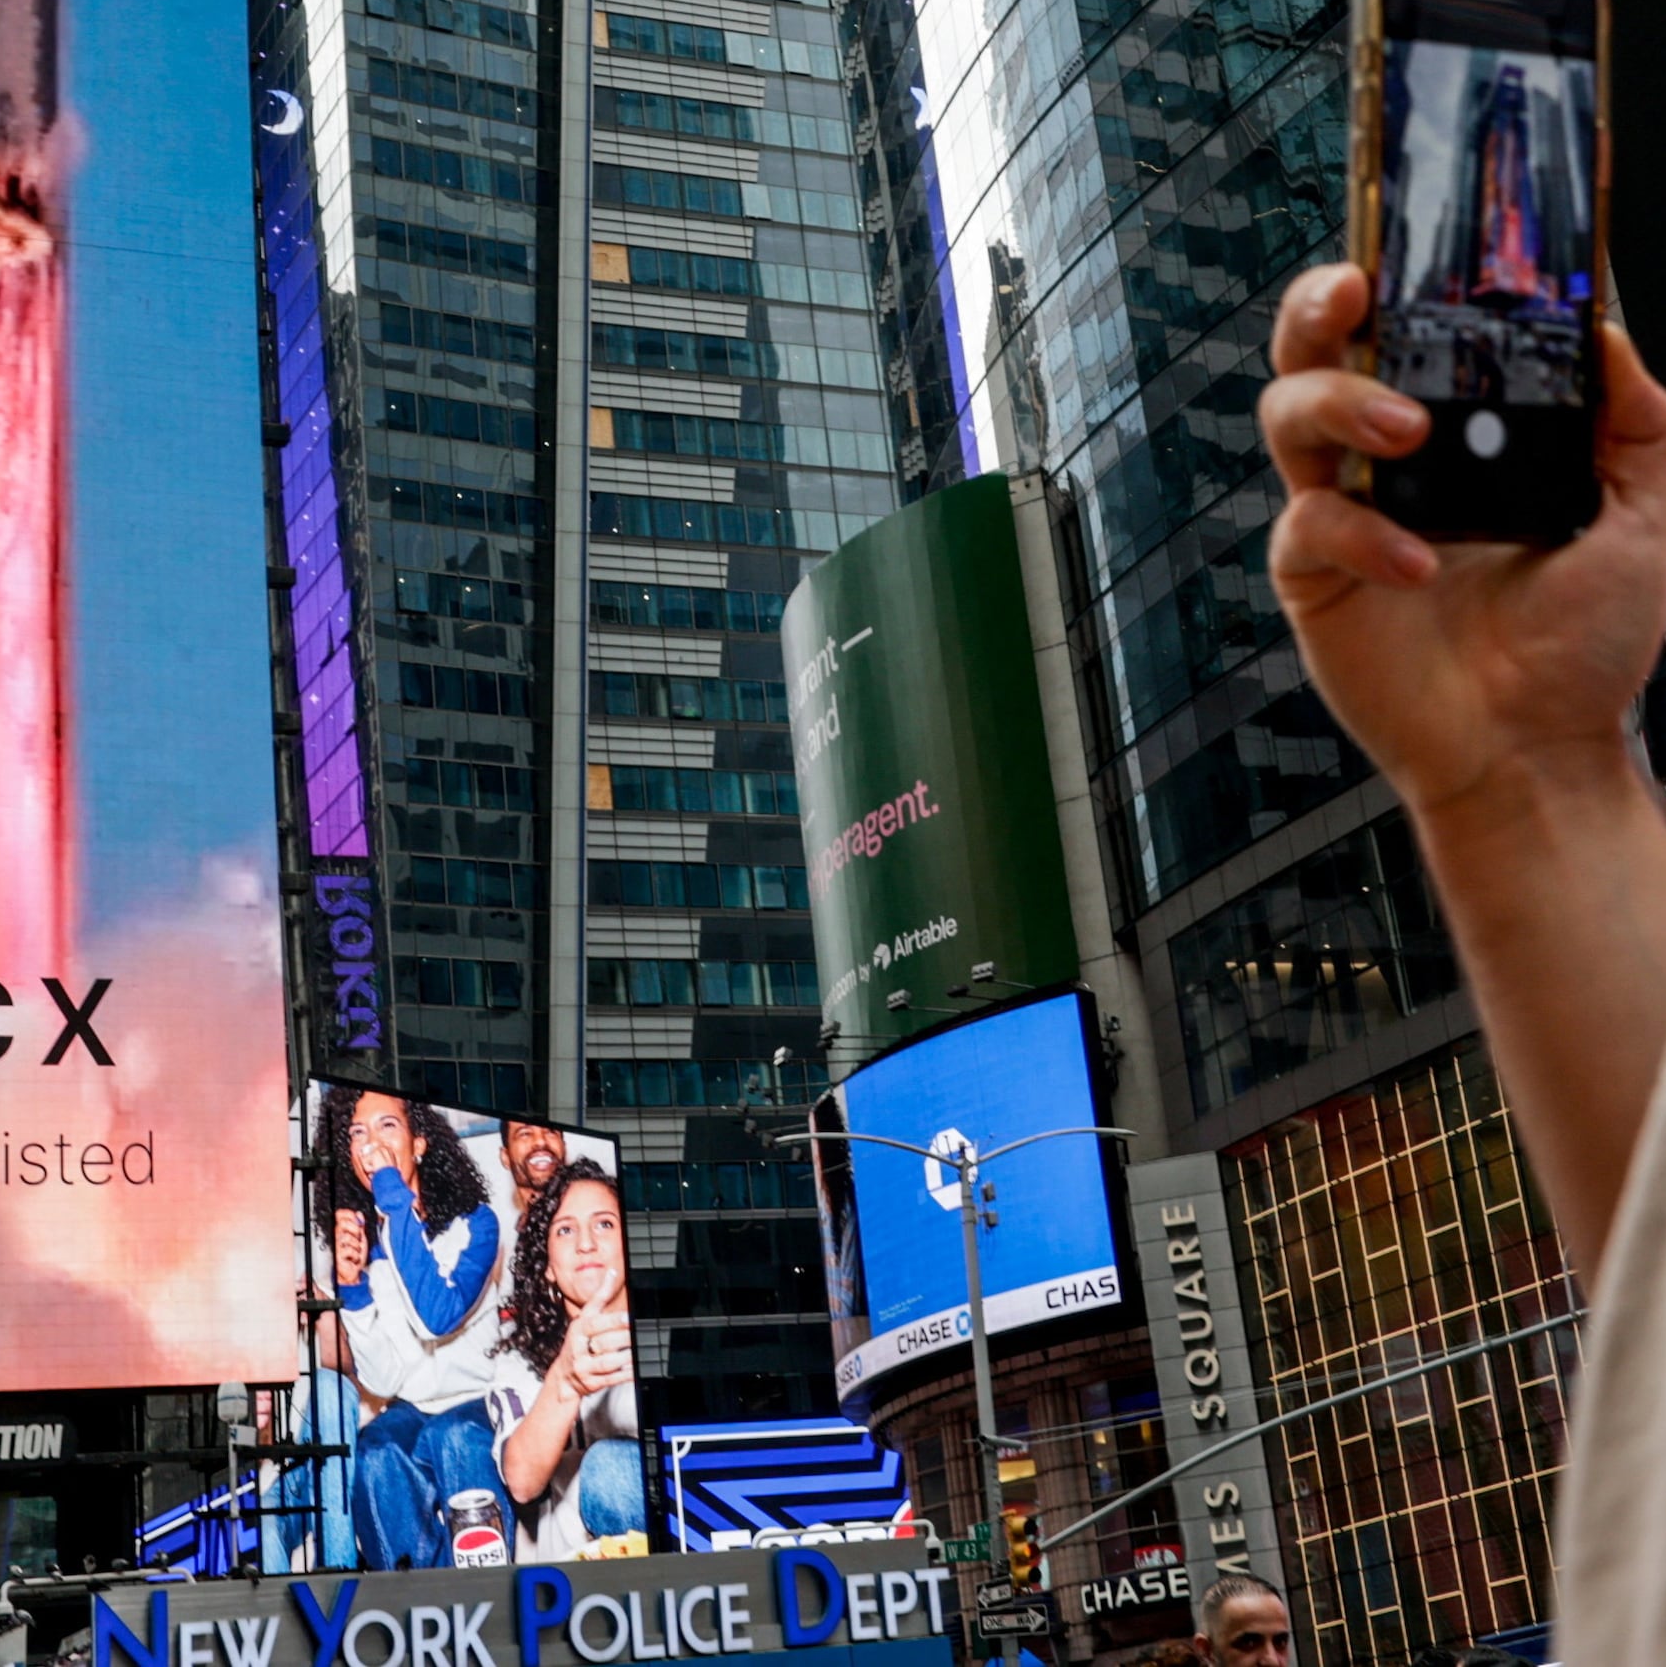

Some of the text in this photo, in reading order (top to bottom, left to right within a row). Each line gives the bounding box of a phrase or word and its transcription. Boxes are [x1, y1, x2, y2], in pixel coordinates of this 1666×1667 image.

[807, 692, 841, 761] and
[893, 915, 959, 962] Airtable
[896, 1318, 952, 1355] CHASE
[1161, 1202, 1227, 1424] SQUARE
[946, 1542, 959, 1560] W
[963, 1542, 978, 1559] 43
[91, 1549, 951, 1667] NEW YORK POLICE DEPT
[1081, 1567, 1191, 1615] CHASE
